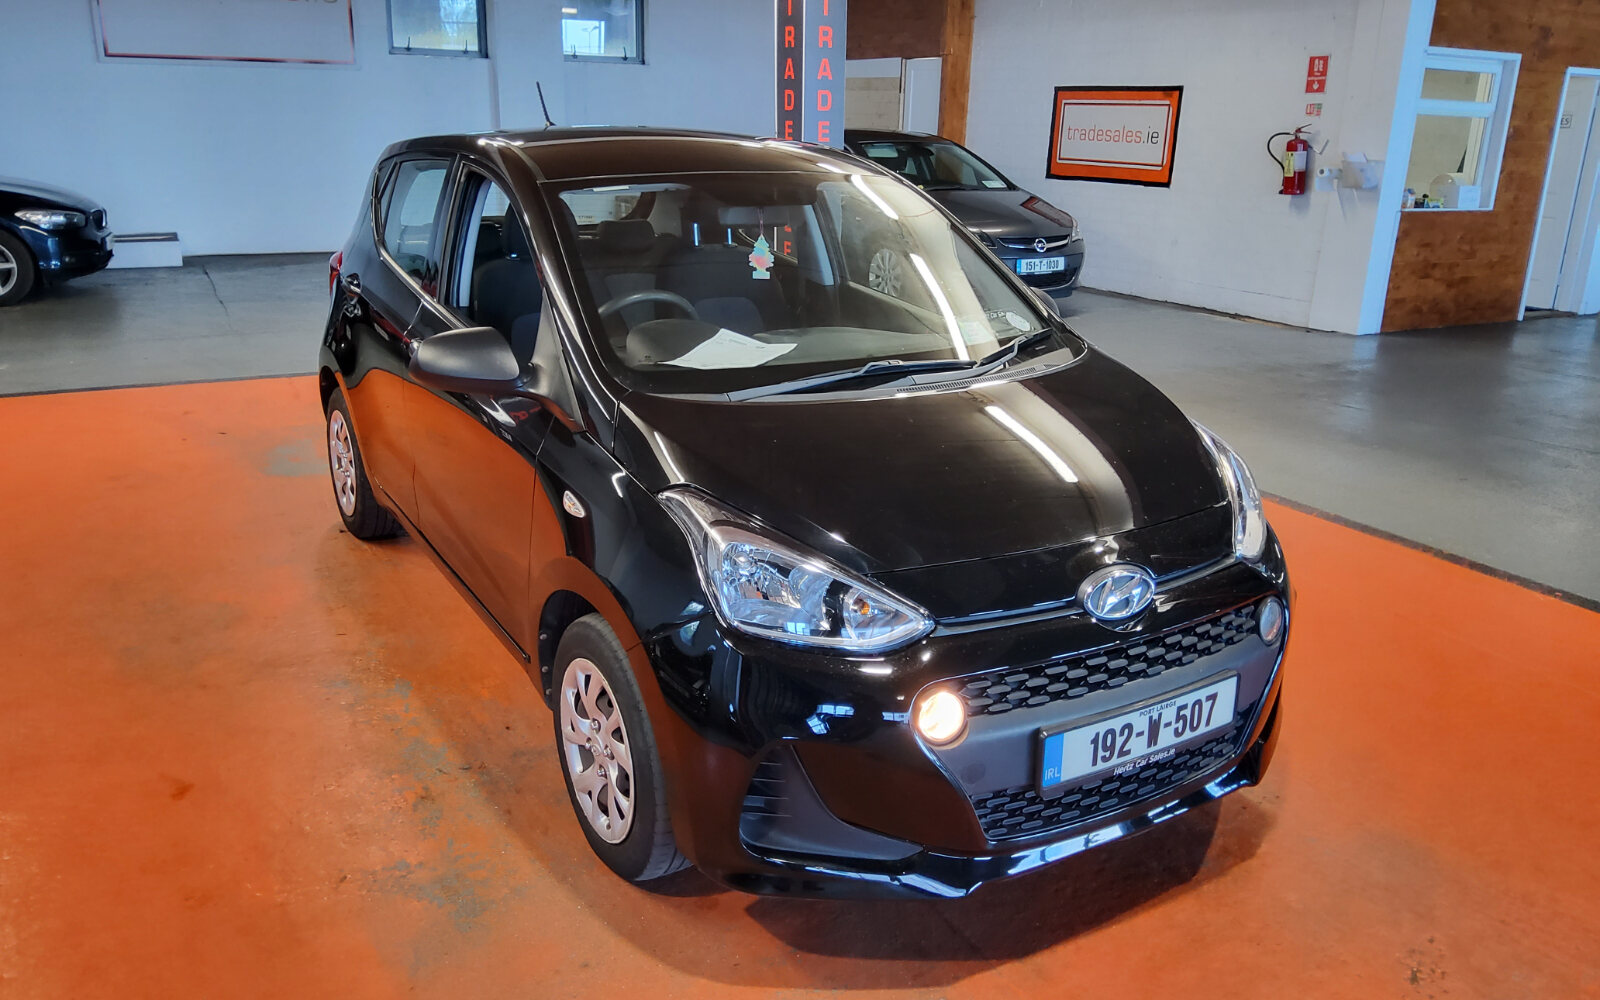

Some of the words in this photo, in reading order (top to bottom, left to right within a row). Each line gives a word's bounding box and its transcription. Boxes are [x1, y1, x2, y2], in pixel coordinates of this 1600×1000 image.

[1067, 124, 1159, 145] tradesales.ie
[1139, 707, 1155, 717] PORT
[1090, 691, 1219, 767] 192-W-507
[1113, 762, 1135, 776] Hertz
[1135, 757, 1149, 768] Car
[1148, 748, 1176, 763] Sales.ie
[1044, 766, 1061, 781] IRL
